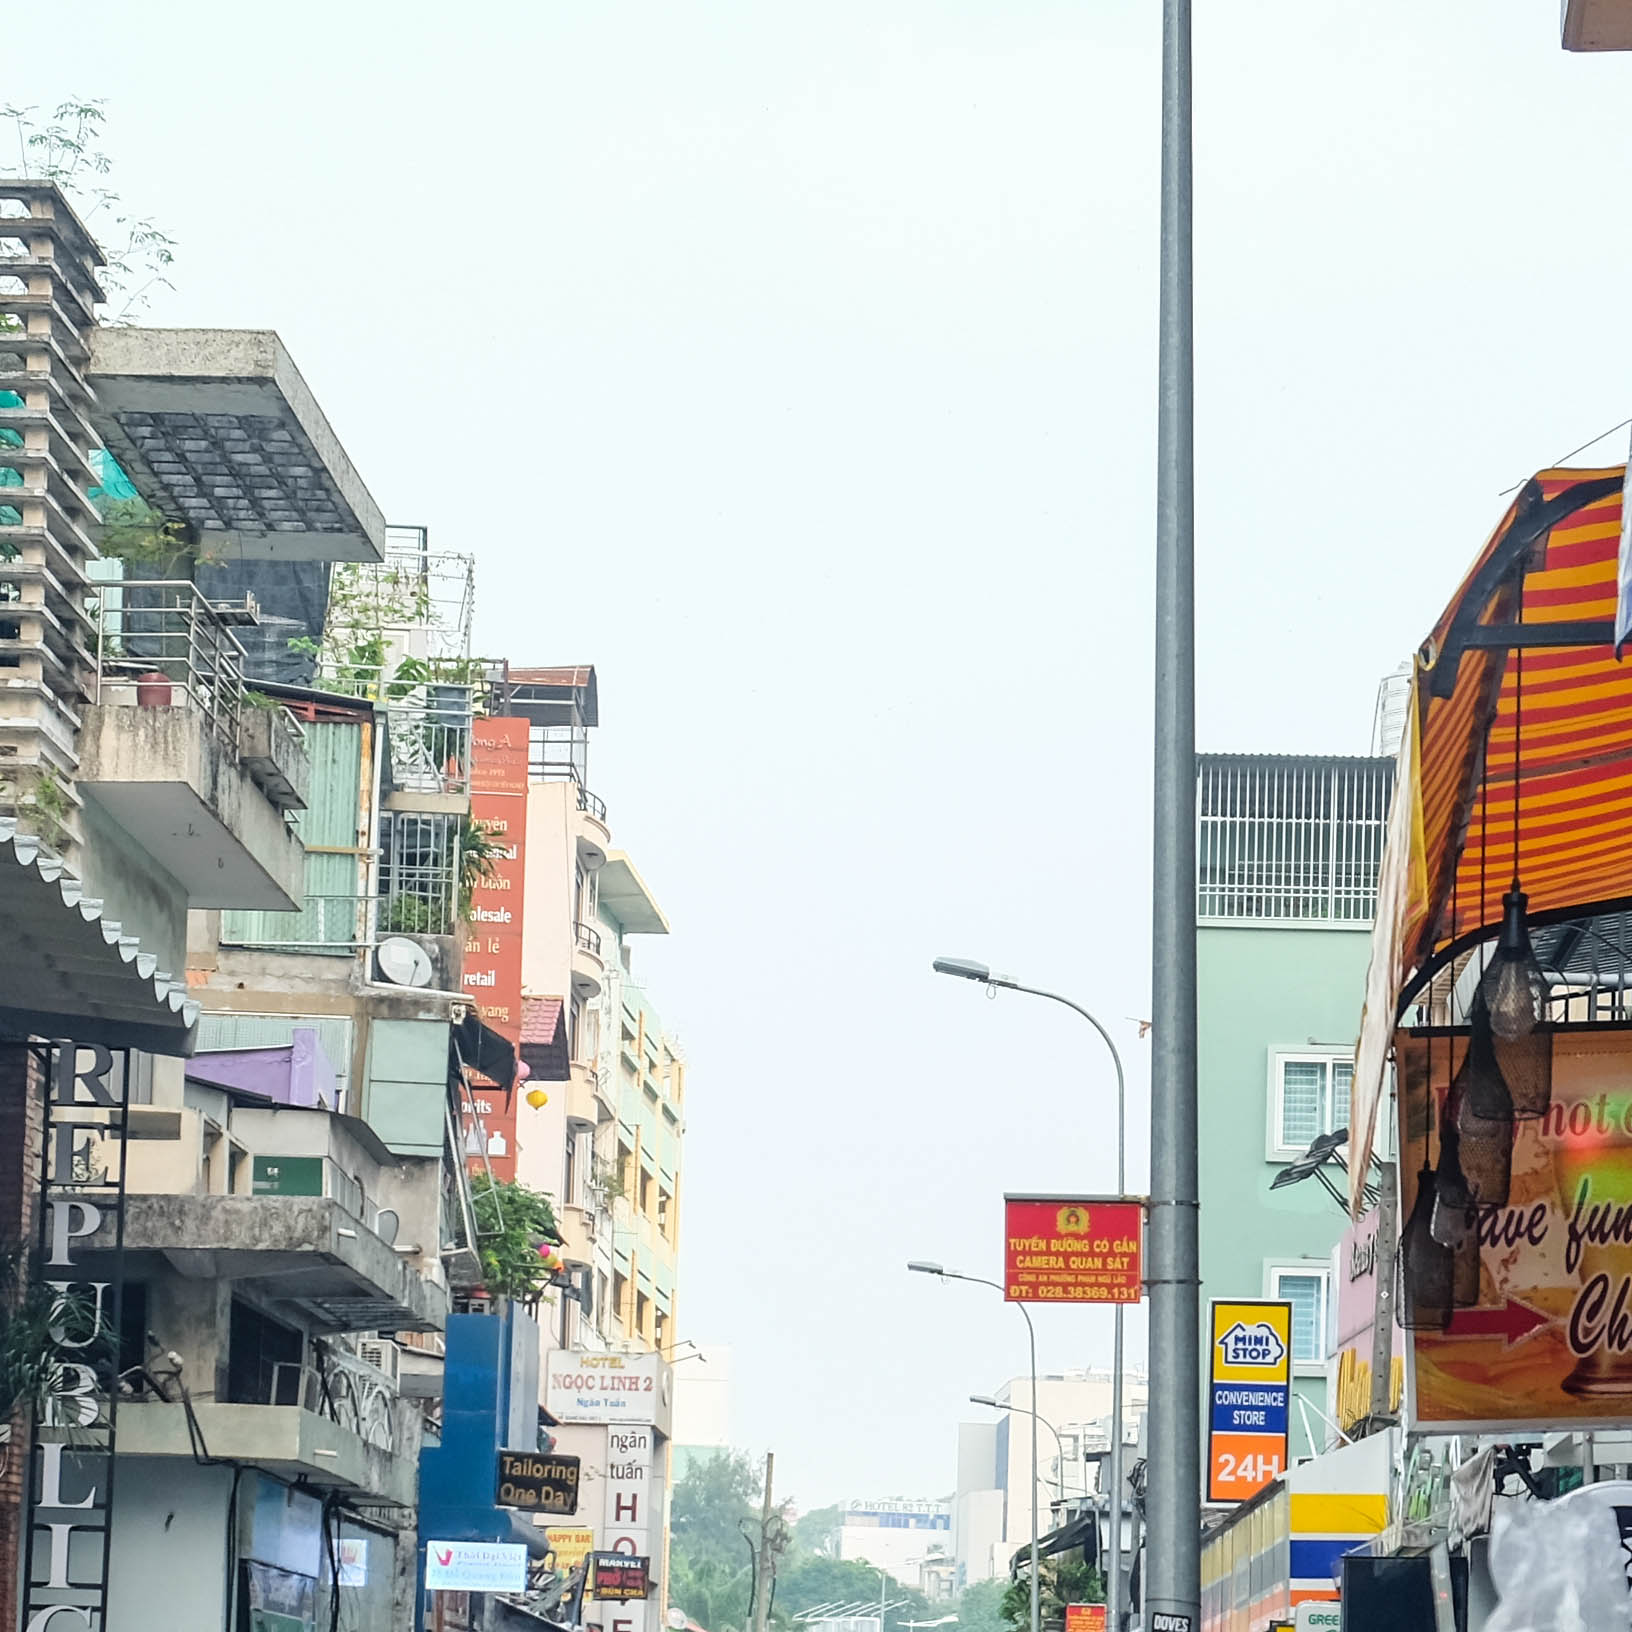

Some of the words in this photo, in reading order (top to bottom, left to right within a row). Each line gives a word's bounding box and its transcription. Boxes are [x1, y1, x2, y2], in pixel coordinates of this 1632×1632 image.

[1542, 1091, 1610, 1138] not
[1474, 1200, 1548, 1248] ave
[1016, 1255, 1066, 1269] CAMERA
[1069, 1256, 1103, 1270] QUAN
[1234, 1334, 1270, 1347] MINI
[1231, 1347, 1272, 1361] STOP
[599, 1375, 641, 1392] LINH
[643, 1376, 654, 1392] 2
[1215, 1390, 1285, 1407] CONVENIENCE
[1232, 1410, 1266, 1425] STORE
[610, 1431, 648, 1454] ngân
[503, 1456, 578, 1485] Tailoring
[609, 1459, 644, 1481] tuấn
[1217, 1453, 1280, 1482] 24H
[500, 1483, 536, 1502] One
[1153, 1615, 1190, 1632] DOVES
